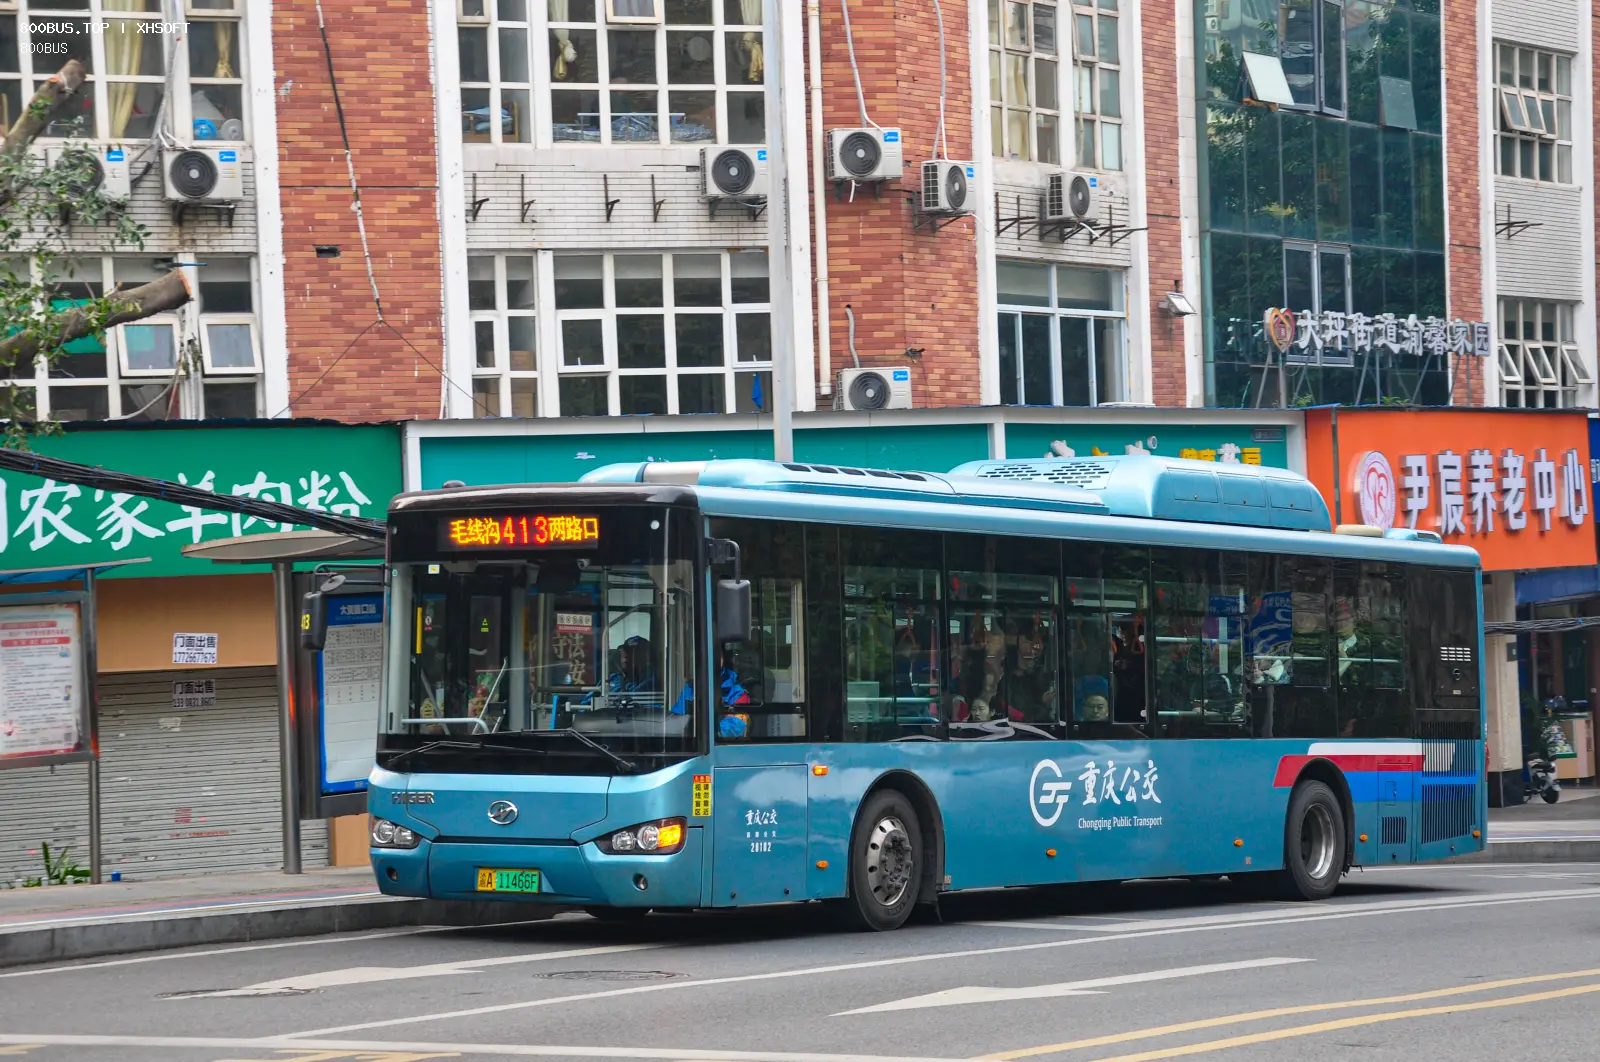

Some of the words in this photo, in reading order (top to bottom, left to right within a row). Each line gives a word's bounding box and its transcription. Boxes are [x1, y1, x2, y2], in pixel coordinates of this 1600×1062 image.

[1297, 309, 1491, 357] 大坪街道渝馨家园
[1399, 448, 1588, 535] 尹宸养老中心
[0, 470, 372, 551] 农家羊肉粉
[450, 517, 500, 544] 毛线沟
[502, 516, 549, 544] 413
[548, 516, 599, 541] 两路口
[174, 635, 216, 648] 门面出售
[173, 680, 215, 694] 门面出售
[1078, 760, 1162, 806] 重庆公交
[744, 809, 778, 825] 重庆公交
[1078, 817, 1111, 831] Chongqing
[1112, 816, 1132, 827] Public
[1133, 816, 1163, 828] Transport
